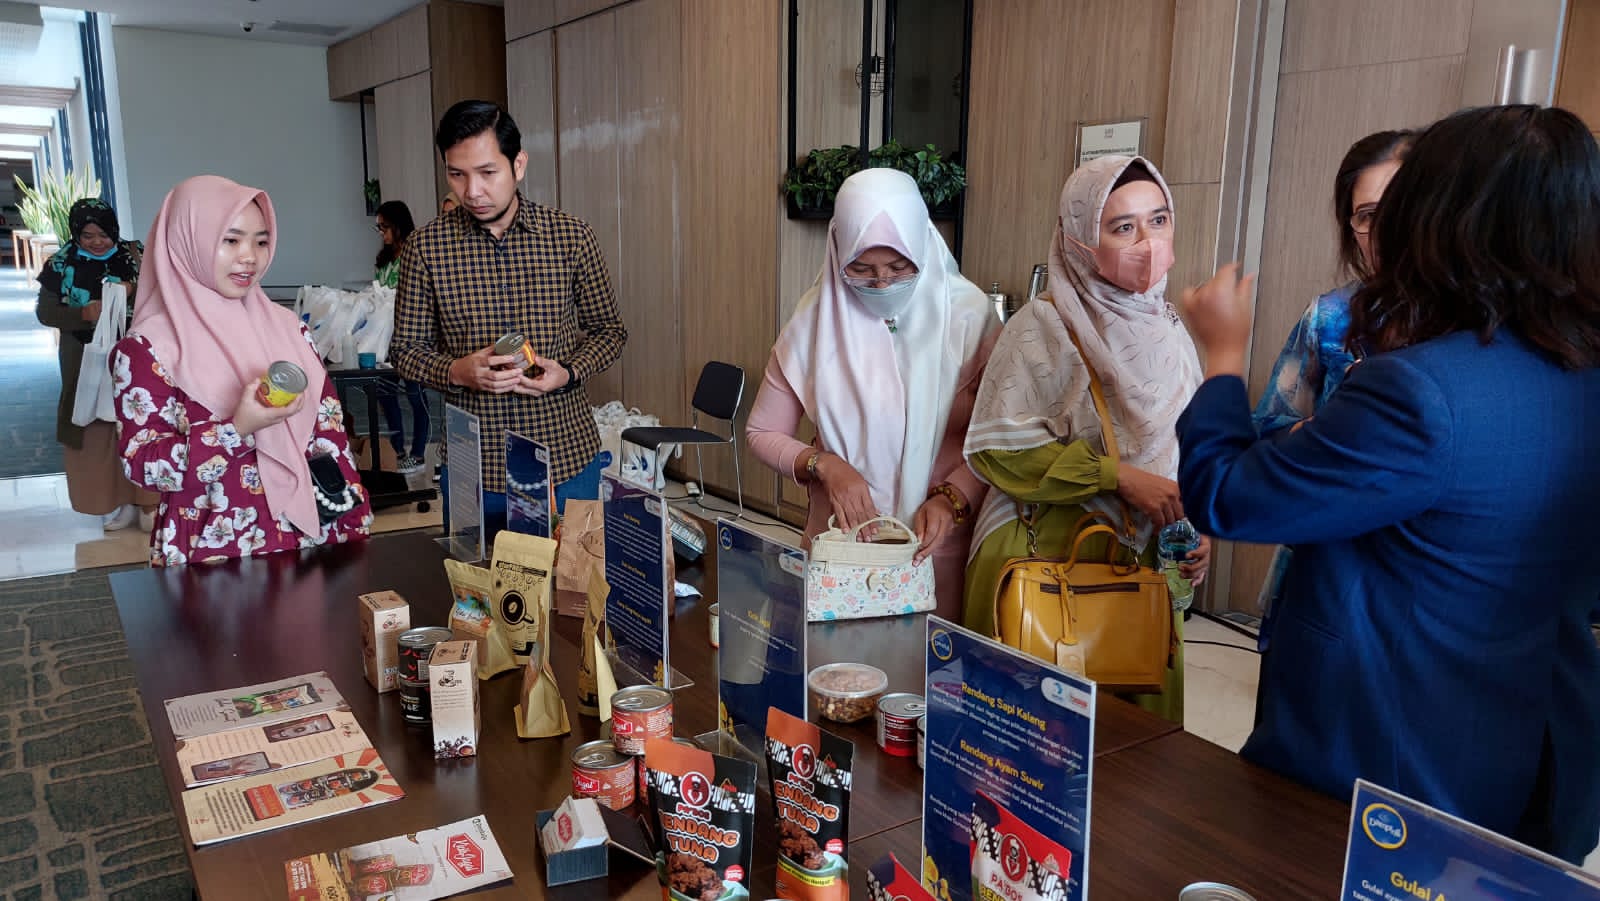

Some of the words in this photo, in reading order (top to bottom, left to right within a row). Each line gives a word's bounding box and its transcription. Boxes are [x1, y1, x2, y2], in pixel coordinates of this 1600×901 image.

[961, 682, 995, 708] Rendang
[997, 698, 1014, 716] Sapi
[1016, 707, 1046, 730] Kaleng
[960, 739, 994, 767] Rendang
[995, 756, 1019, 778] Ayam
[1021, 771, 1045, 791] Suwir
[773, 780, 839, 821] ENDANG
[777, 801, 820, 834] TUNA
[667, 834, 719, 863] TUNA
[1361, 879, 1383, 898] Gulai
[1390, 872, 1431, 901] Gulai
